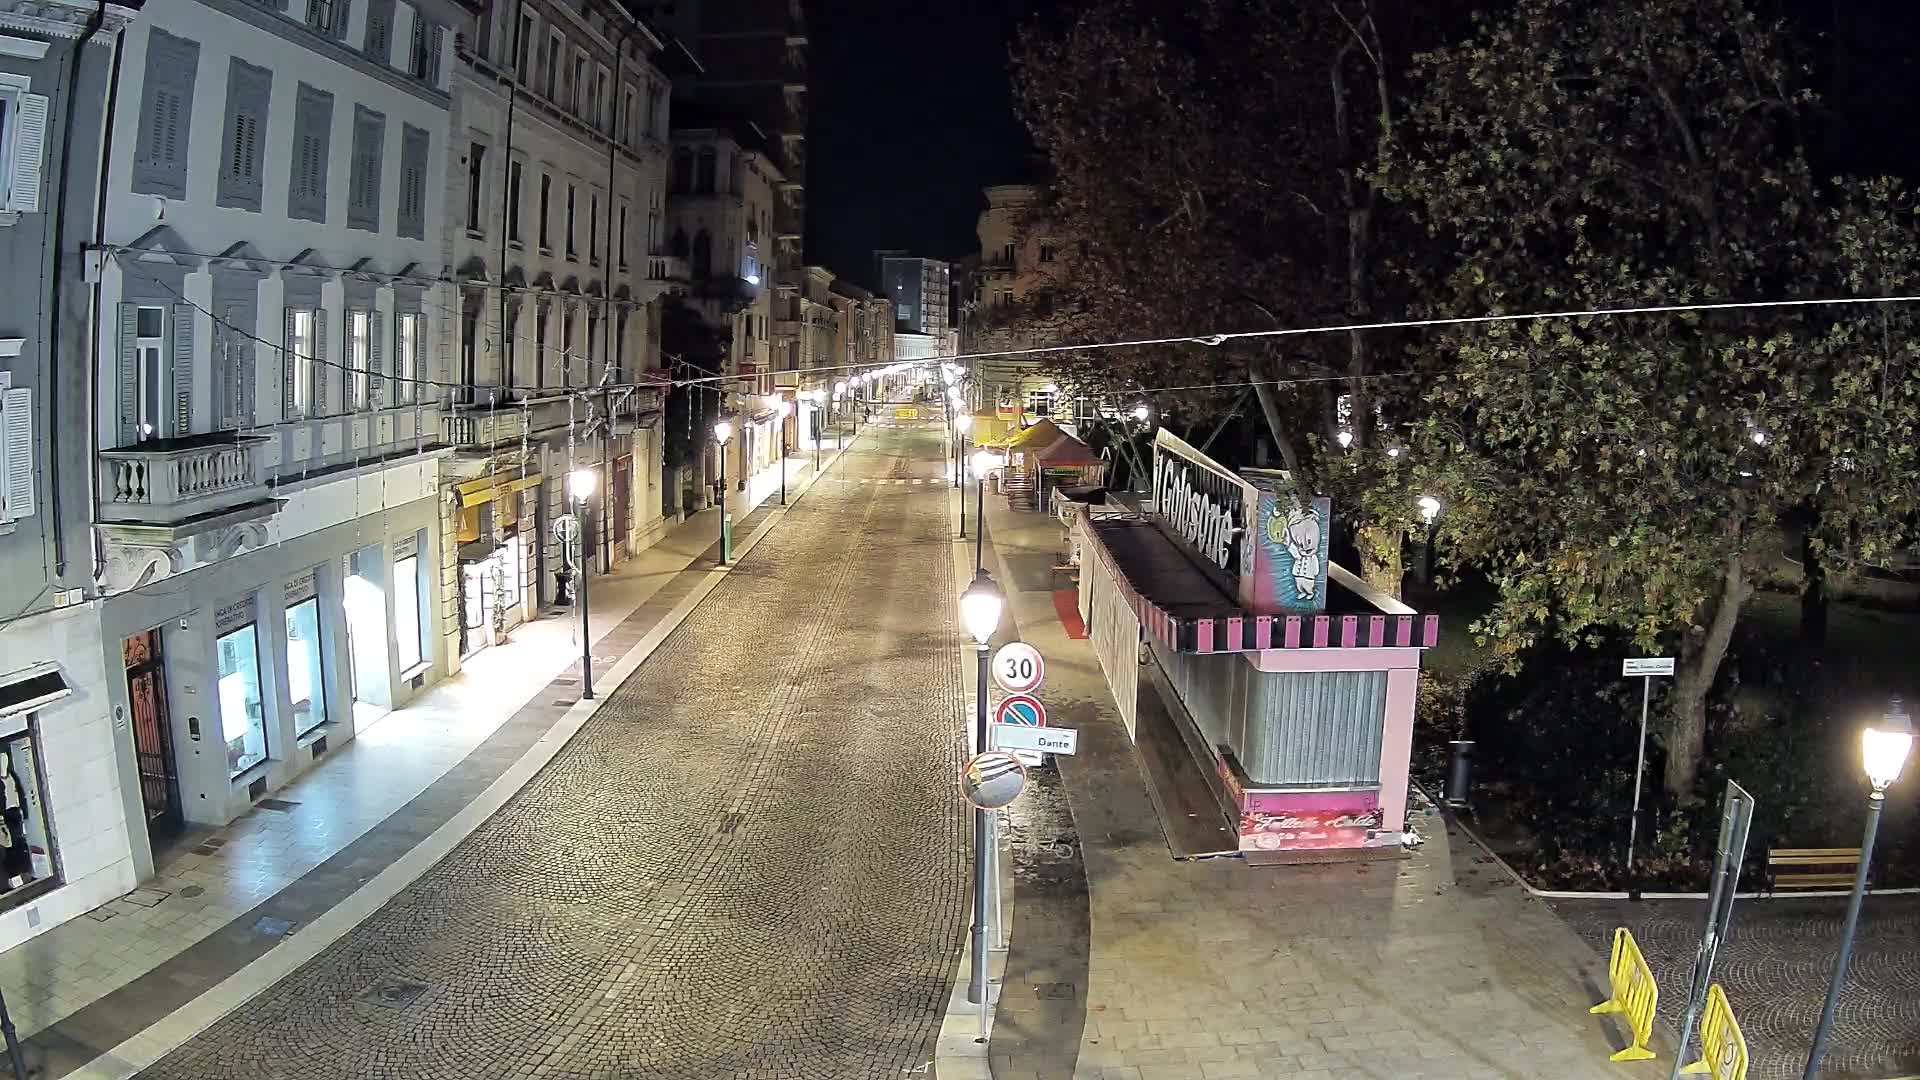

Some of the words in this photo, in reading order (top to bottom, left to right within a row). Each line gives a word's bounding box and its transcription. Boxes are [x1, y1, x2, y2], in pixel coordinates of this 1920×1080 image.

[1162, 458, 1232, 570] Golosone
[1006, 658, 1032, 679] 30
[1038, 737, 1069, 749] Dante
